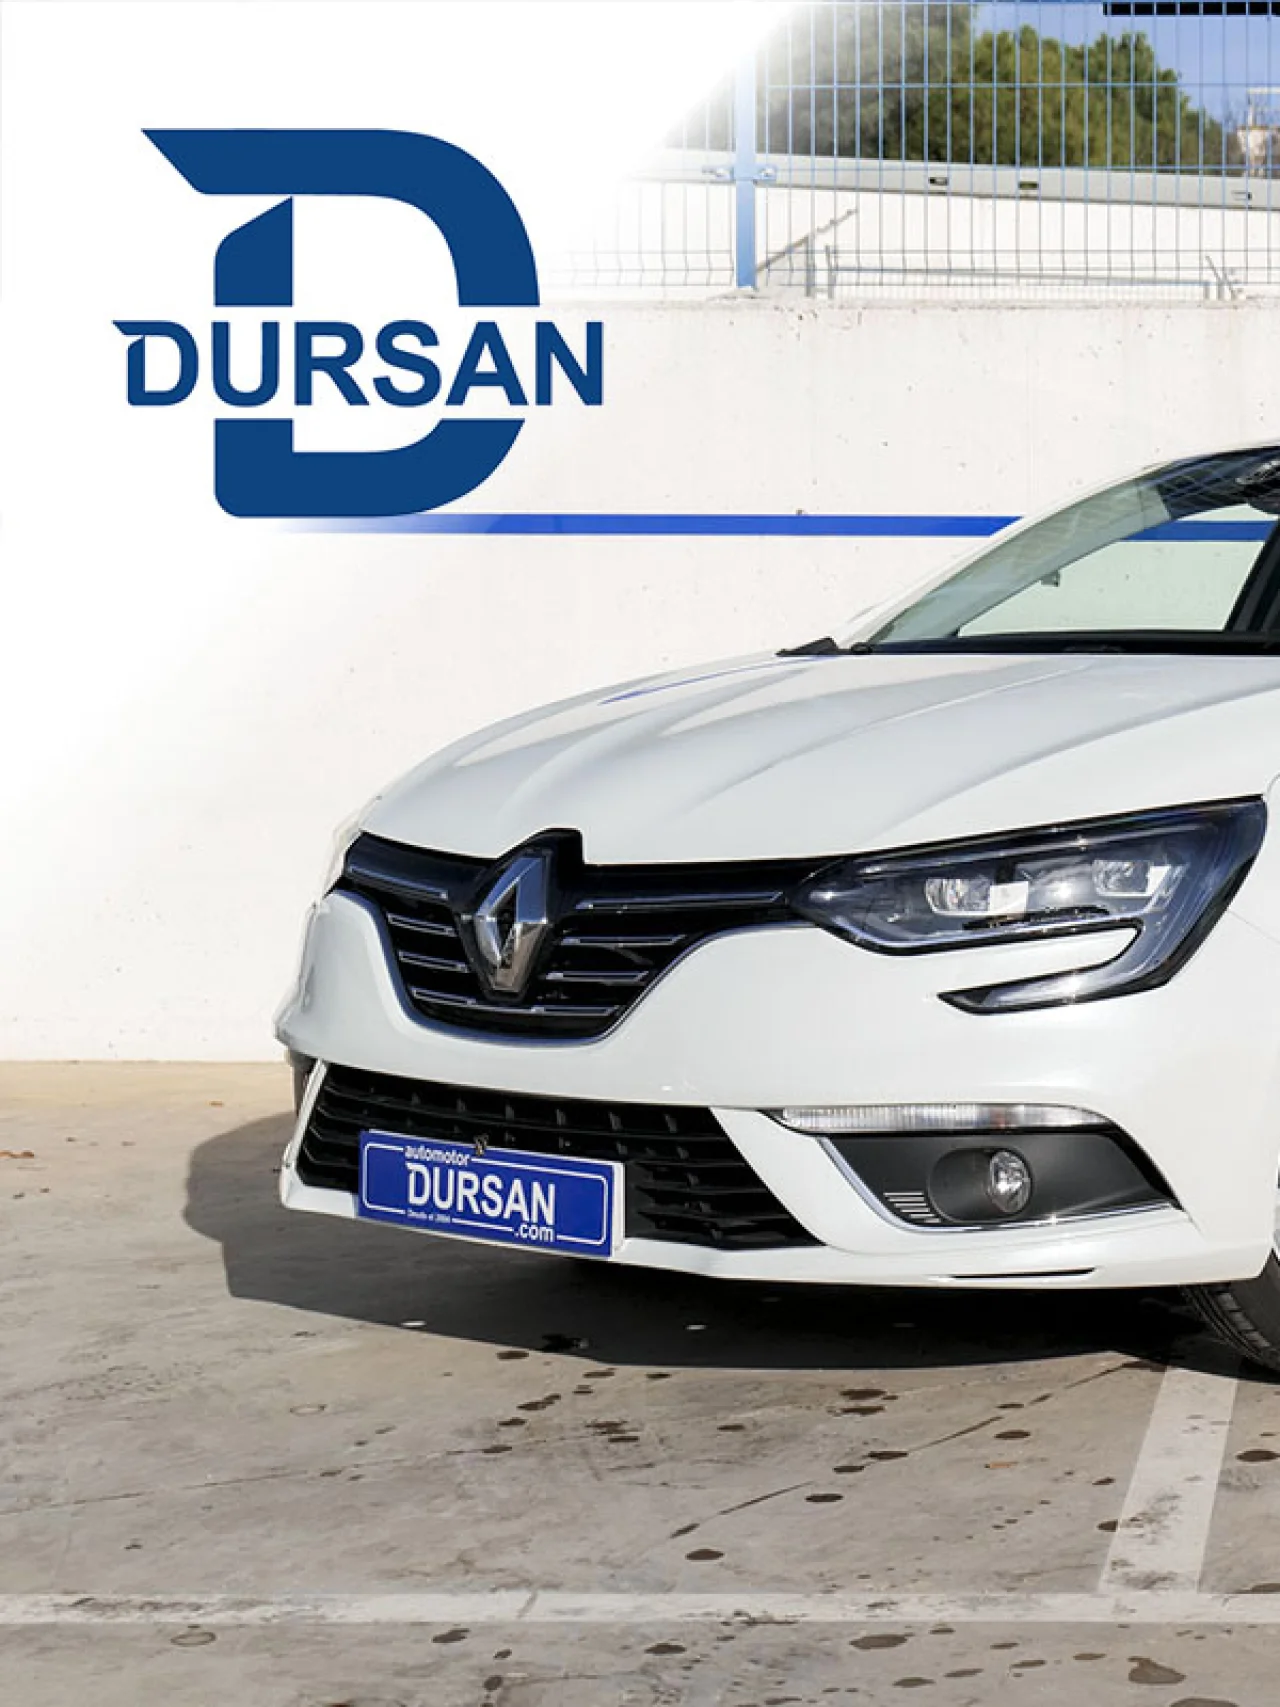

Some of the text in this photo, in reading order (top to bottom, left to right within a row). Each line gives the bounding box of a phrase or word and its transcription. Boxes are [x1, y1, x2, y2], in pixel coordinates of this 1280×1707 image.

[404, 1144, 471, 1166] automotor
[405, 1162, 555, 1225] DURSAN
[513, 1222, 554, 1243] .com
